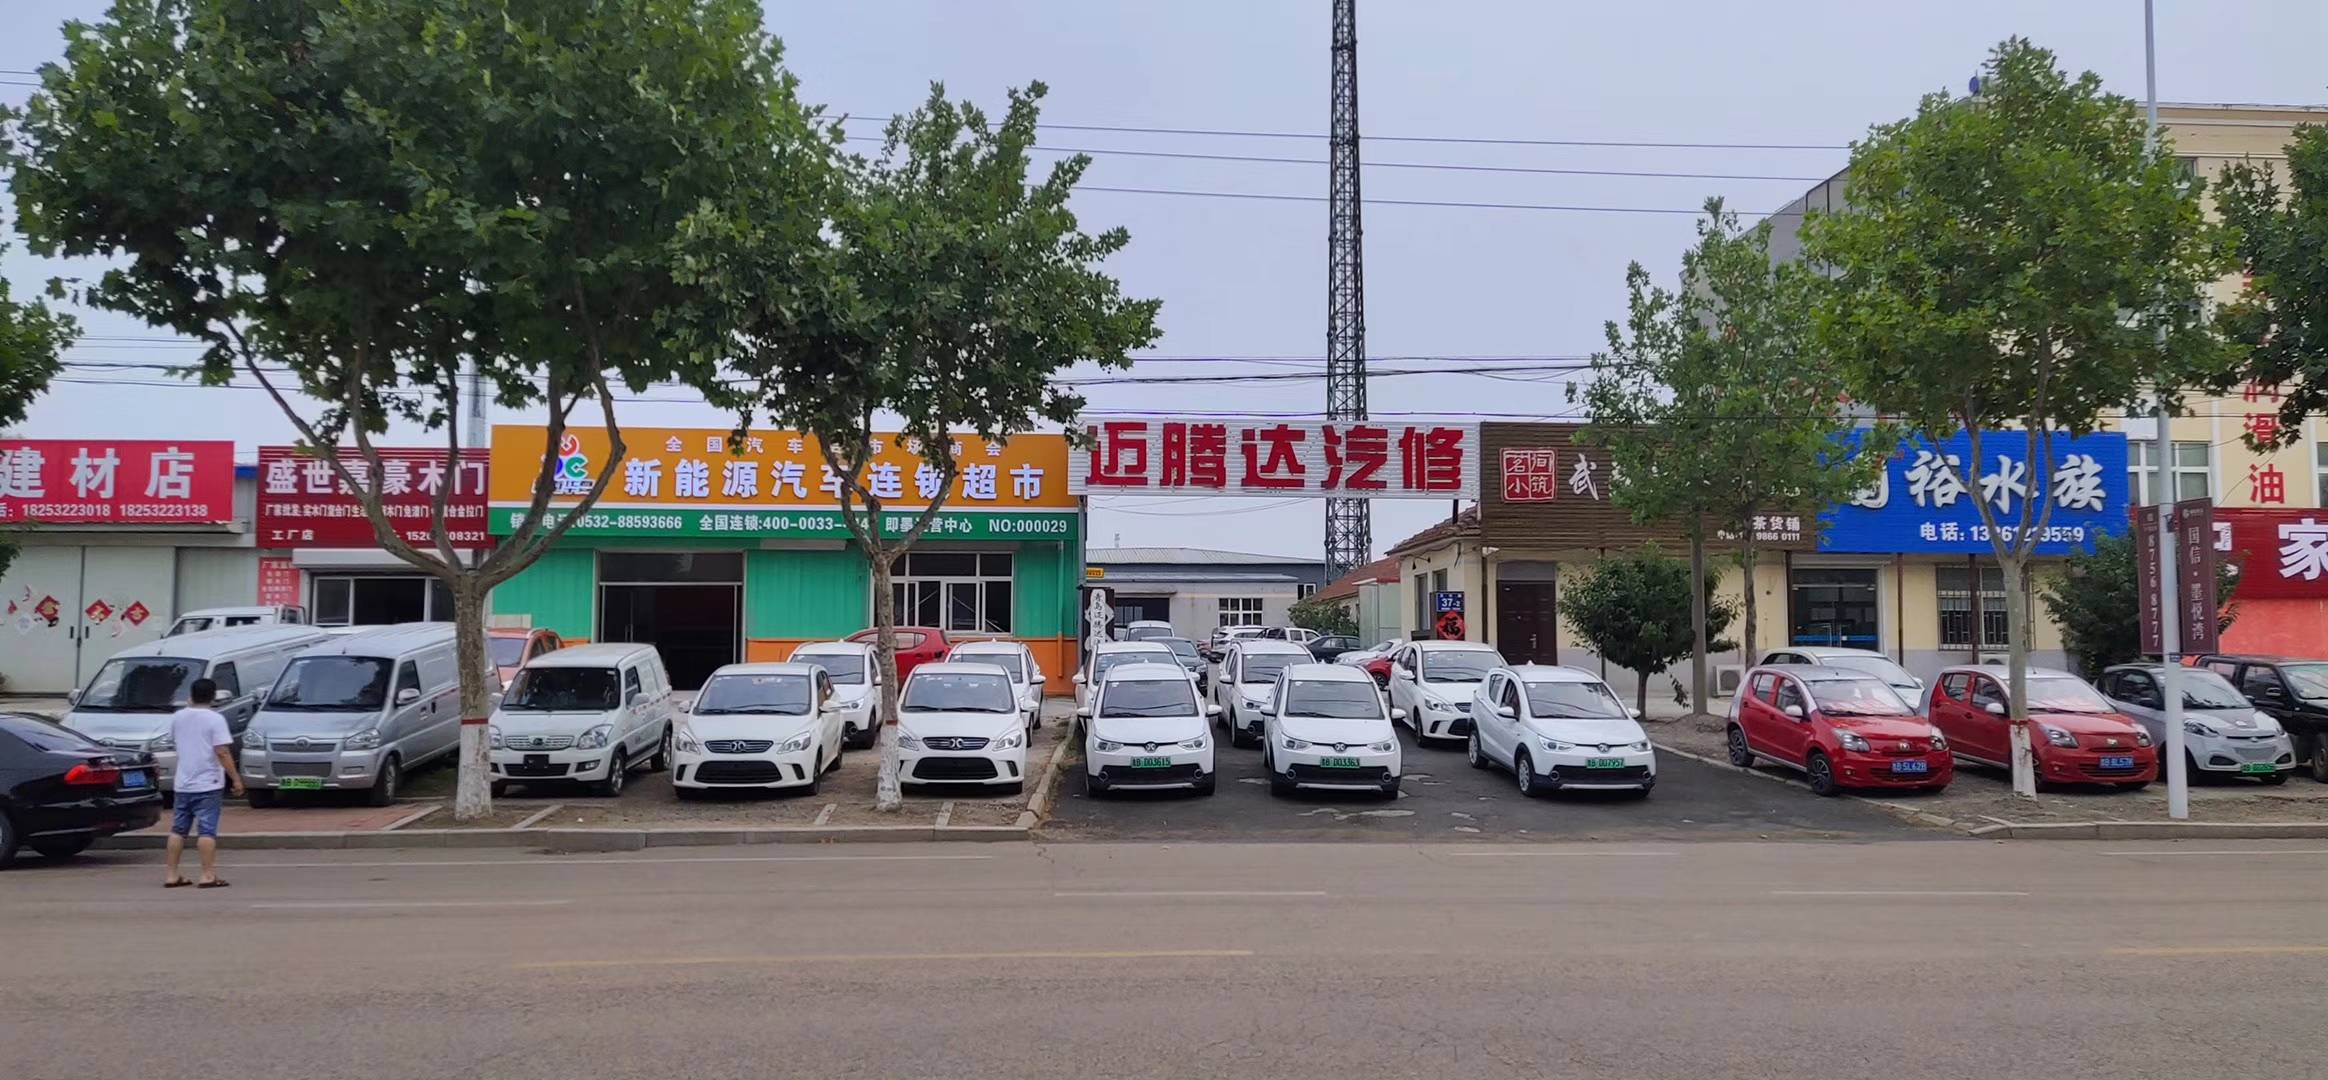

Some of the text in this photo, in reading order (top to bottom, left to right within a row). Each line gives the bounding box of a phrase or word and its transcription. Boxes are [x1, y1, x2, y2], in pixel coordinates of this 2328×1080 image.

[665, 436, 1001, 457] 全国汽车市场商会
[1085, 421, 1465, 491] 迈腾达汽修
[0, 447, 195, 499] 建材店
[624, 457, 1044, 500] 新能源汽车连锁超市
[22, 504, 111, 517] 18253223018
[119, 504, 208, 518] 18253223138
[885, 517, 973, 533] 即墨营中心
[988, 519, 1067, 533] NO:000029
